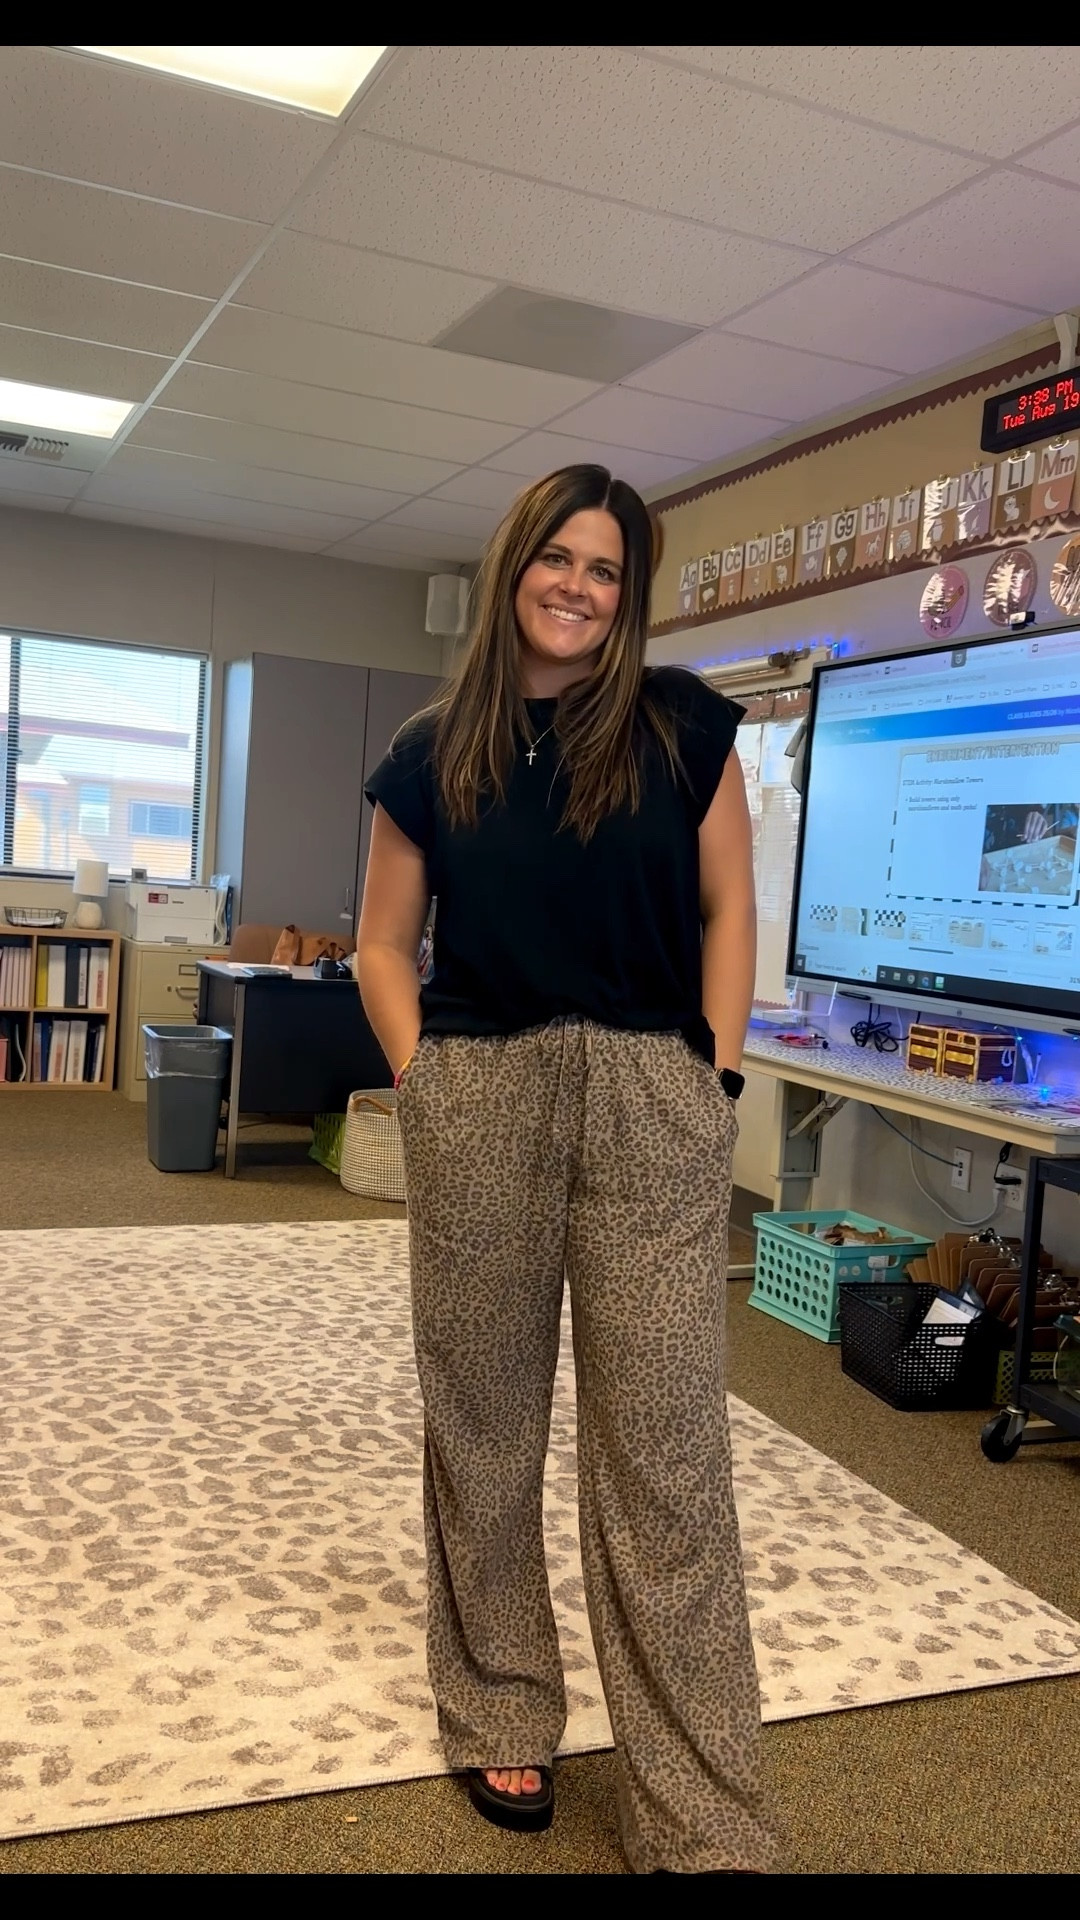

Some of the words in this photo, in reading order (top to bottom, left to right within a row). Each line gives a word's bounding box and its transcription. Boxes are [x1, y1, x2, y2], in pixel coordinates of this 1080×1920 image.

[1018, 387, 1050, 410] 3:38
[1056, 379, 1074, 398] PM
[1003, 414, 1026, 430] Tue
[1032, 403, 1056, 421] Aug
[1063, 392, 1080, 411] 19
[1008, 460, 1026, 491] Ll
[1041, 452, 1076, 480] Mm
[962, 470, 989, 502] Kk
[834, 513, 855, 539] Gg
[865, 502, 886, 531] Hh
[775, 534, 792, 560] Ee
[807, 523, 824, 551] Ff
[725, 550, 741, 572] Cc
[749, 541, 768, 567] Dd
[681, 564, 697, 589] Aa
[702, 558, 718, 581] Bb
